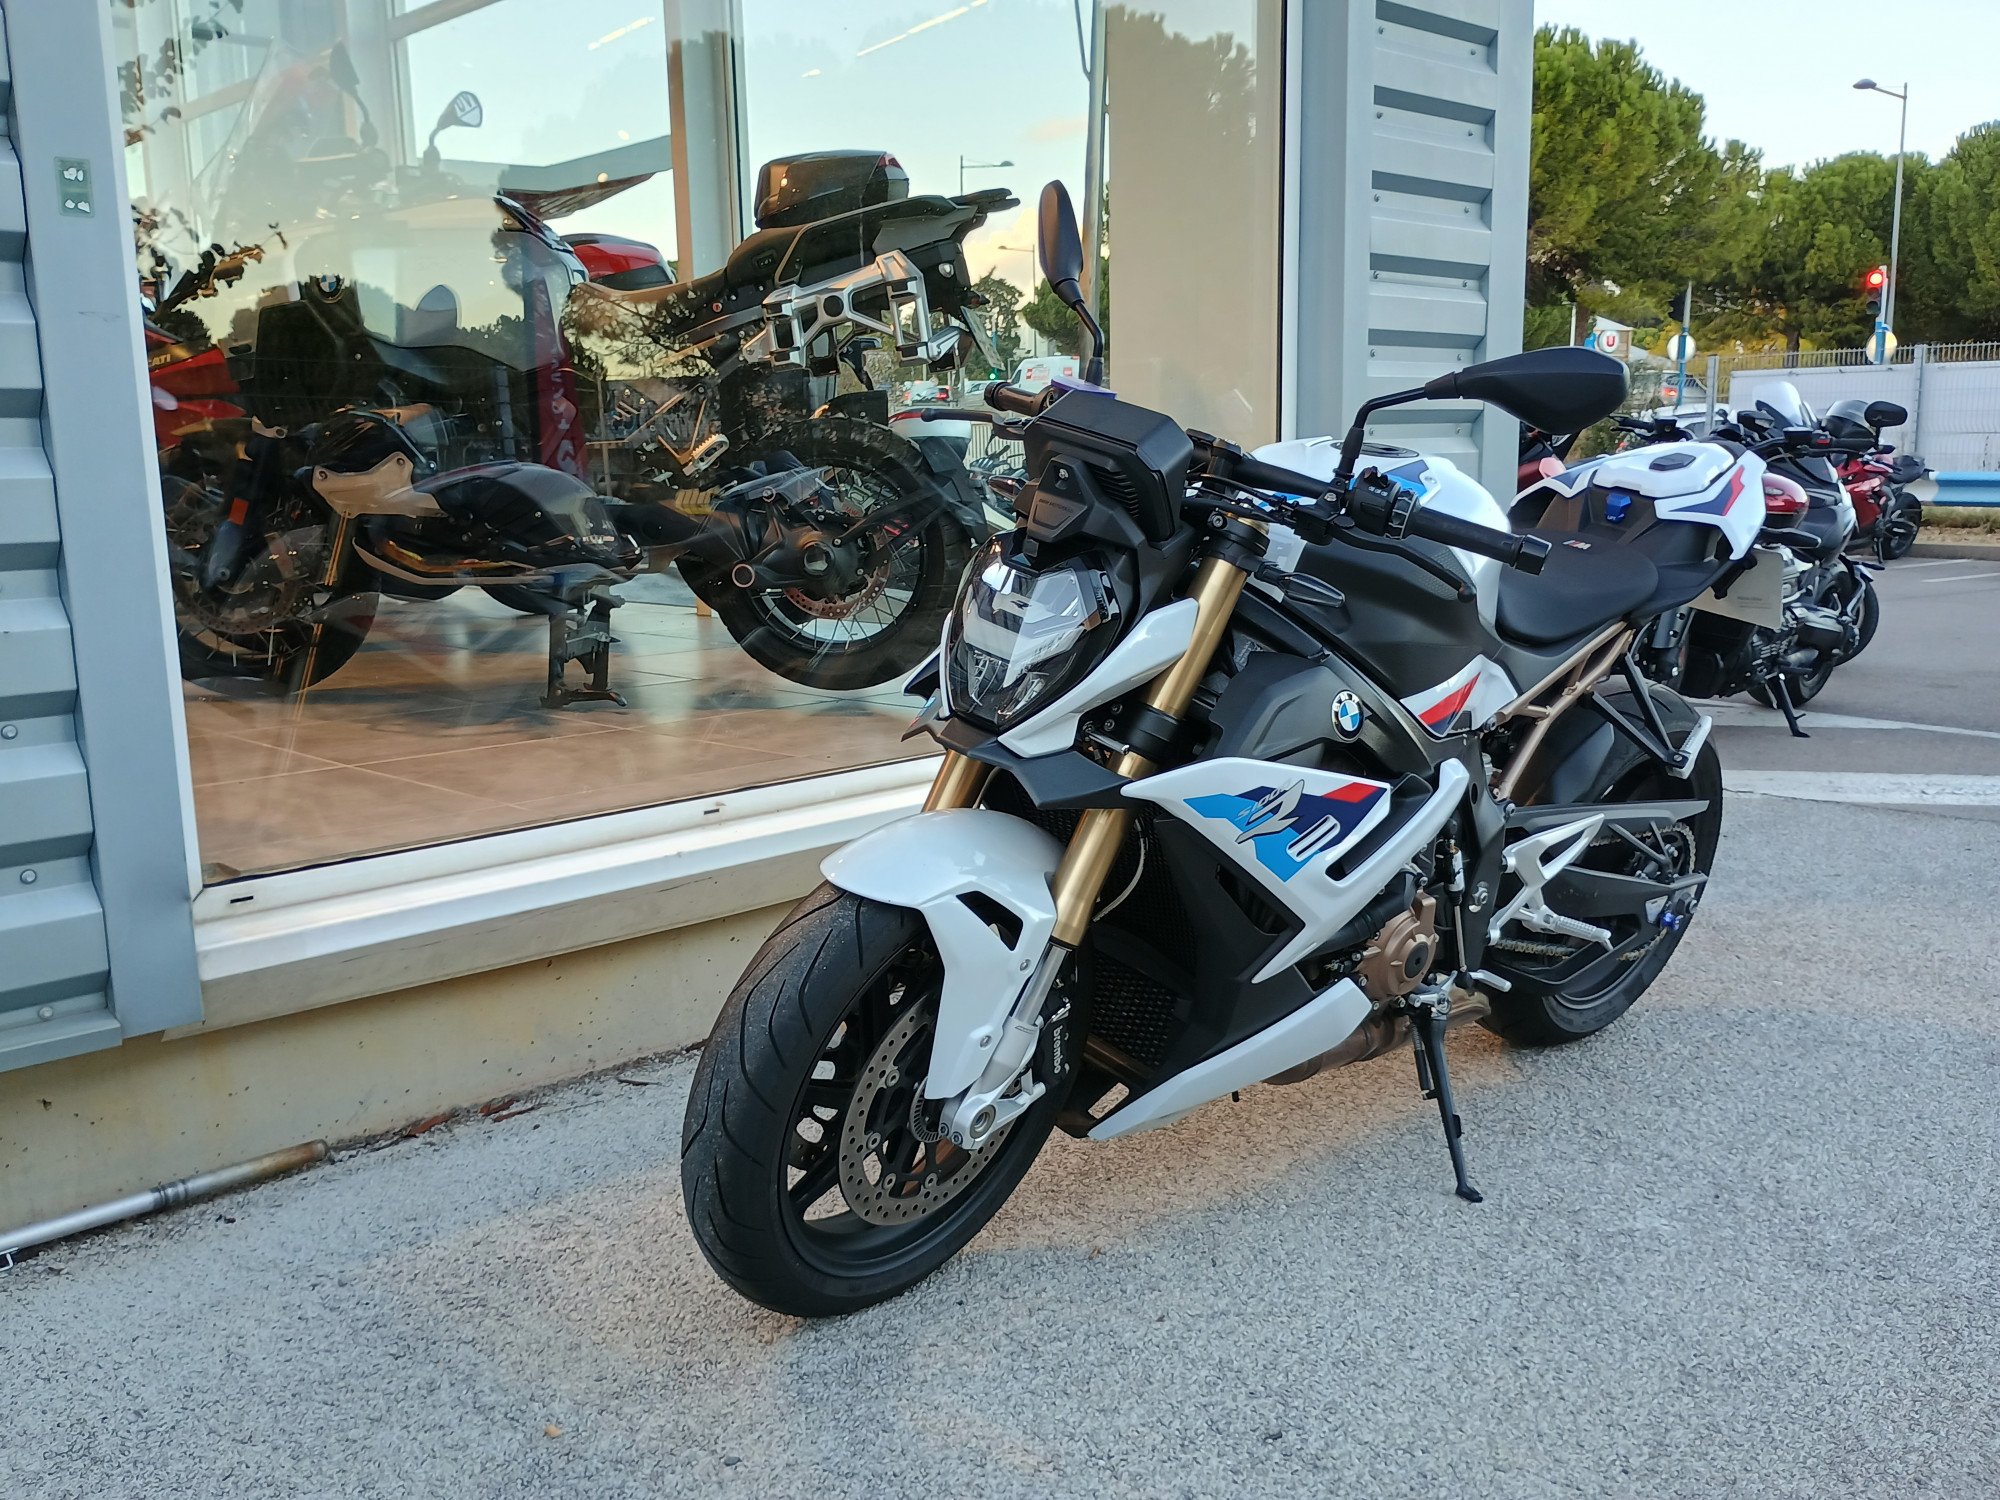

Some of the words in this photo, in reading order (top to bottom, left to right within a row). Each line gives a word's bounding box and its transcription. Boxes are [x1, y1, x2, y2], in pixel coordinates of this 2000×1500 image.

[1606, 336, 1616, 348] U
[149, 353, 171, 367] ATI
[1332, 691, 1360, 712] BMW
[1053, 1025, 1064, 1074] brembo
